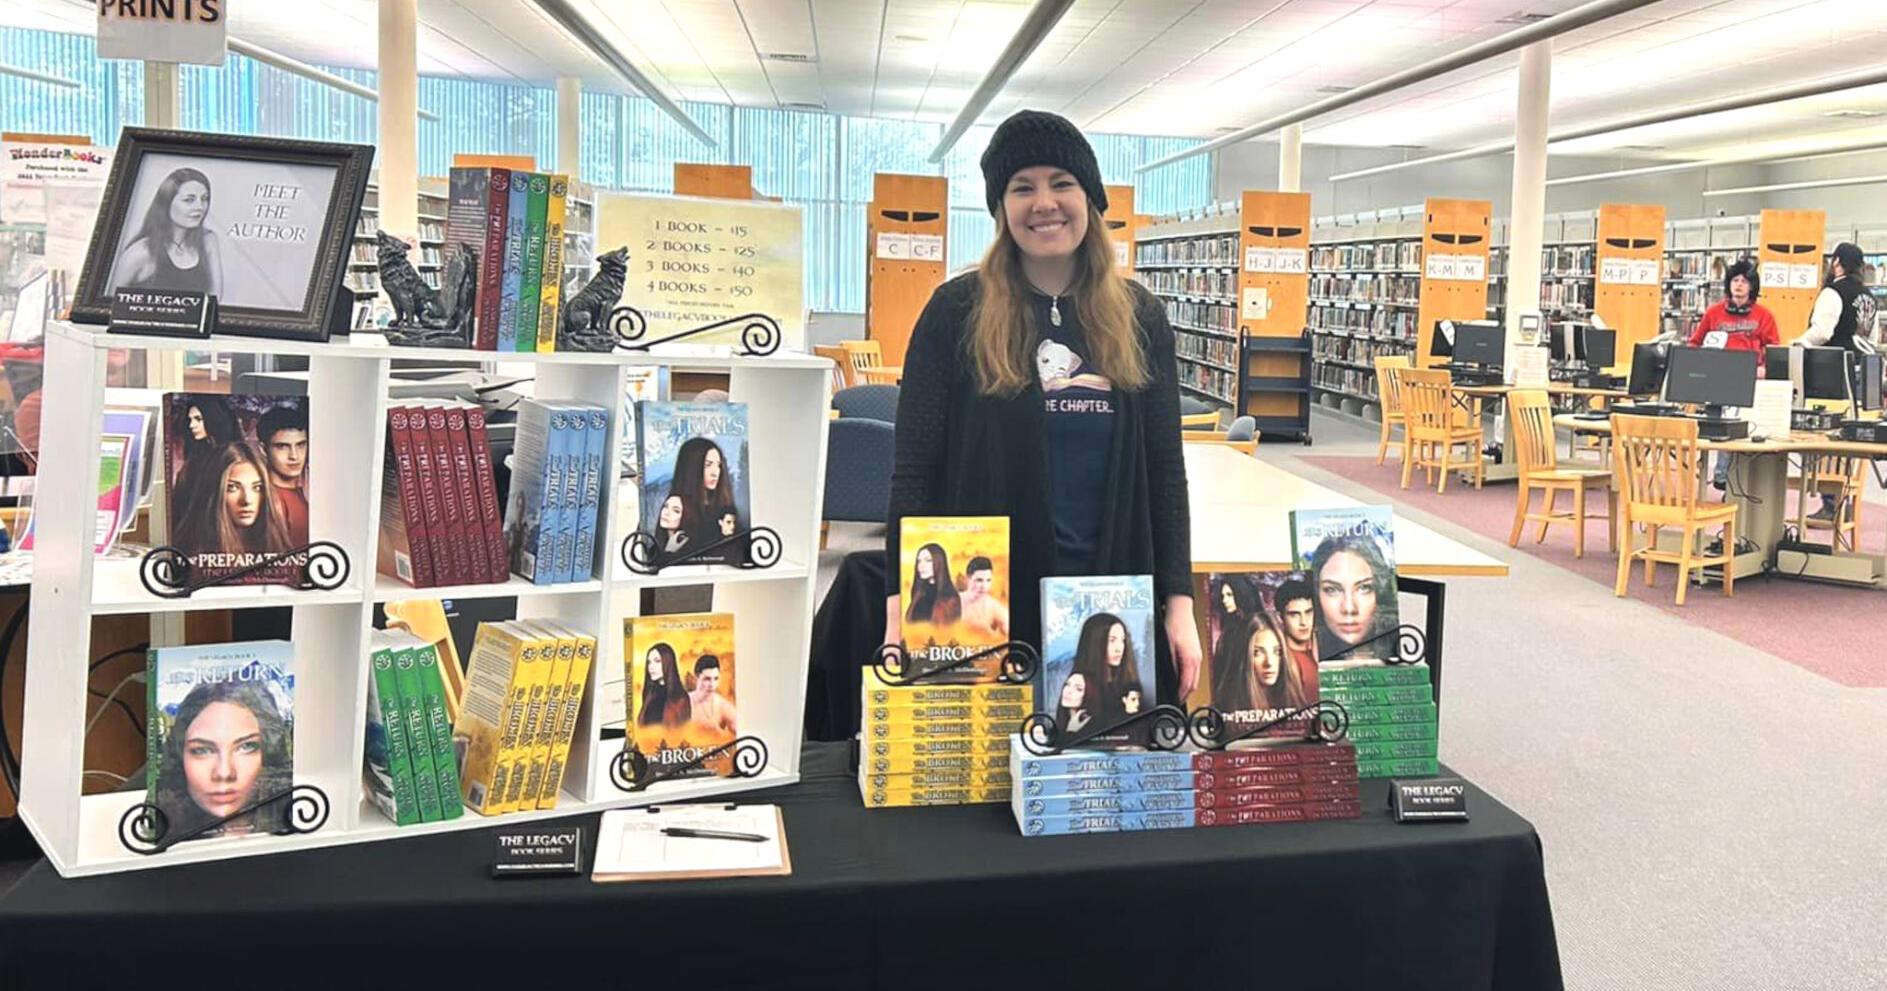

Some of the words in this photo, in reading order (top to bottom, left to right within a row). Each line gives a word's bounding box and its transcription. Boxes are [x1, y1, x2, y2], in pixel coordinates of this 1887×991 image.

[101, 0, 218, 21] PRINTS
[254, 184, 301, 199] MEET
[255, 204, 290, 219] THE
[226, 223, 306, 240] AUTHOR
[656, 220, 660, 231] 1
[668, 221, 707, 233] BOOK
[646, 240, 656, 250] 2
[663, 241, 711, 253] BOOKS
[889, 243, 898, 254] C
[914, 244, 940, 257] C-F
[646, 260, 654, 272] 3
[662, 261, 710, 273] BOOKS
[1249, 256, 1271, 269] H-J
[1279, 257, 1302, 270] J-K
[1428, 264, 1453, 276] K-M
[1464, 265, 1475, 276] M
[1603, 268, 1627, 280] M-P
[1640, 270, 1648, 280] P
[1765, 272, 1785, 284] P-S
[1799, 273, 1808, 285] S
[647, 280, 655, 293] 4
[658, 281, 707, 293] BOOKS
[117, 293, 144, 304] THE
[147, 294, 200, 306] LEGACY
[674, 415, 745, 436] TRIALS
[1075, 589, 1151, 610] TRIALS
[197, 663, 285, 685] RETURN
[1402, 785, 1422, 796] THE
[1424, 785, 1464, 796] LEGACY
[499, 834, 524, 846] THE
[526, 834, 575, 846] LEGACY
